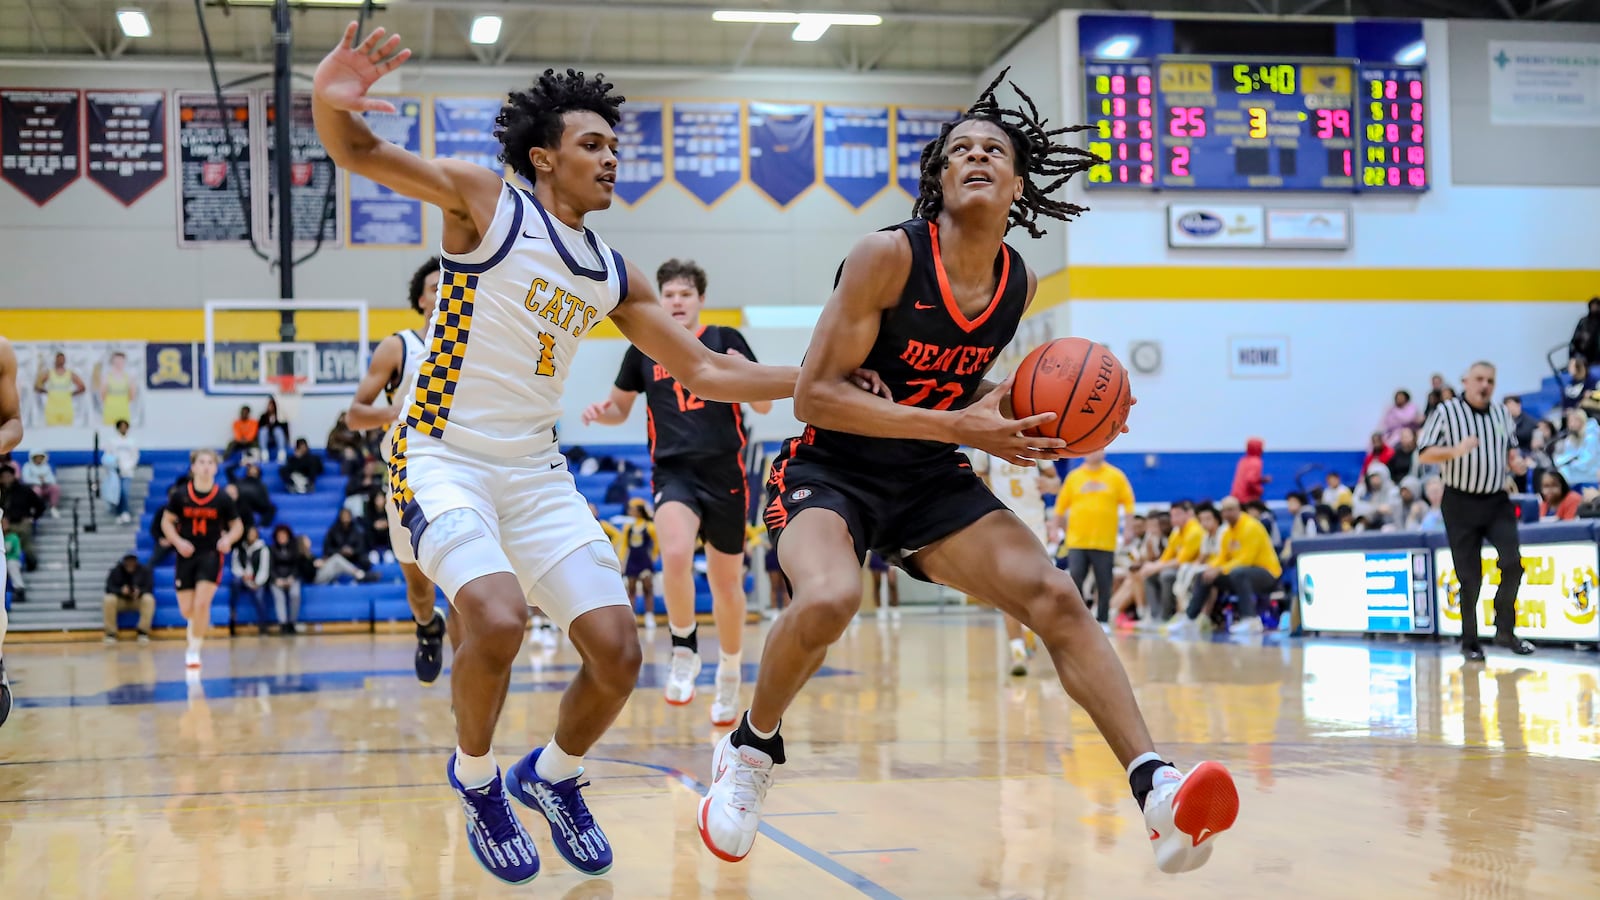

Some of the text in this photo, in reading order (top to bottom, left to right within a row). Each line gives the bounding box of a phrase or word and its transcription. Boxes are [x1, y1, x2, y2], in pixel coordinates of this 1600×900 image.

[1233, 64, 1296, 95] 5:40
[1385, 80, 1398, 100] 2
[1102, 98, 1111, 116] 1
[1391, 102, 1399, 121] 1
[1410, 102, 1423, 122] 2
[1112, 119, 1126, 139] 2
[1138, 119, 1152, 139] 5
[1170, 106, 1206, 138] 25
[1248, 107, 1267, 139] 3
[1316, 108, 1351, 139] 39
[1411, 124, 1424, 143] 2
[1118, 142, 1127, 161] 1
[1171, 145, 1190, 176] 2
[1343, 149, 1352, 177] 1
[1367, 146, 1385, 163] 14
[1392, 146, 1400, 163] 1
[1119, 164, 1128, 183] 1
[524, 277, 598, 337] CATS
[535, 331, 556, 377] 1
[1238, 346, 1279, 366] HOME
[1079, 354, 1114, 415] OHSAA
